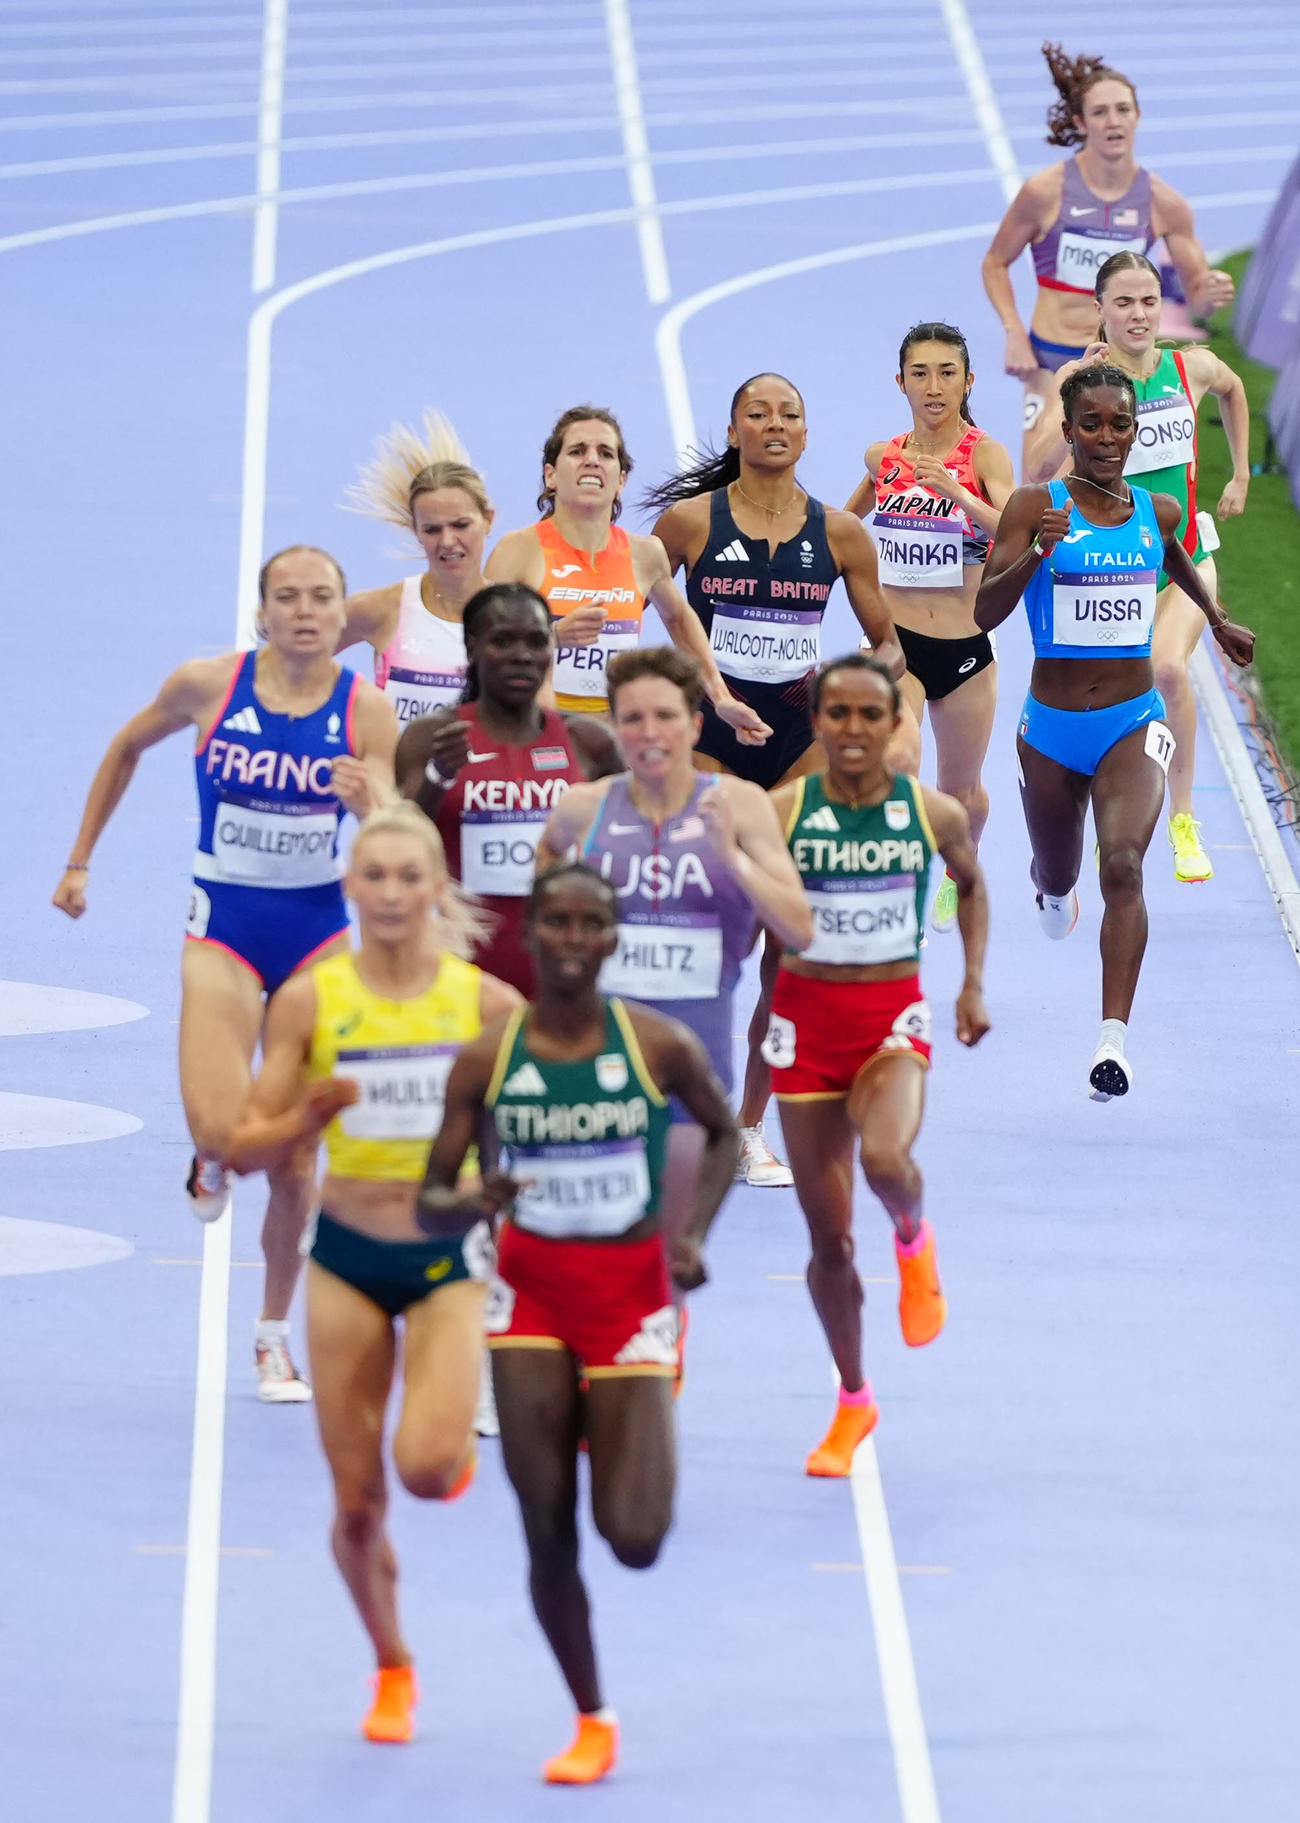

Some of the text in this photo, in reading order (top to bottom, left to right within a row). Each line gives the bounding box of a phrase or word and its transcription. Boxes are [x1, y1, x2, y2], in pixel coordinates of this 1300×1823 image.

[1062, 245, 1111, 268] MAC
[1138, 418, 1194, 447] ONSO
[877, 494, 955, 518] JAPAN
[888, 518, 936, 529] PARIS 2024
[878, 537, 958, 566] TANAKA
[1084, 552, 1146, 567] ITALIA
[701, 576, 830, 601] GREAT BRITAIN
[1082, 575, 1135, 583] PARIS 2024
[547, 586, 635, 604] ESPAÑA
[743, 609, 799, 622] PARIS 2024
[1075, 598, 1142, 622] VISSA
[713, 628, 817, 661] WALCOTT-NOLAN
[1157, 733, 1171, 763] 11
[206, 738, 333, 796] FRANC
[464, 778, 570, 812] KENYA
[482, 840, 534, 866] EJO
[793, 838, 924, 872] ETHIOPIA
[601, 851, 714, 900] USA
[621, 943, 695, 972] HILTZ
[494, 1097, 649, 1143] ETHIOPIA
